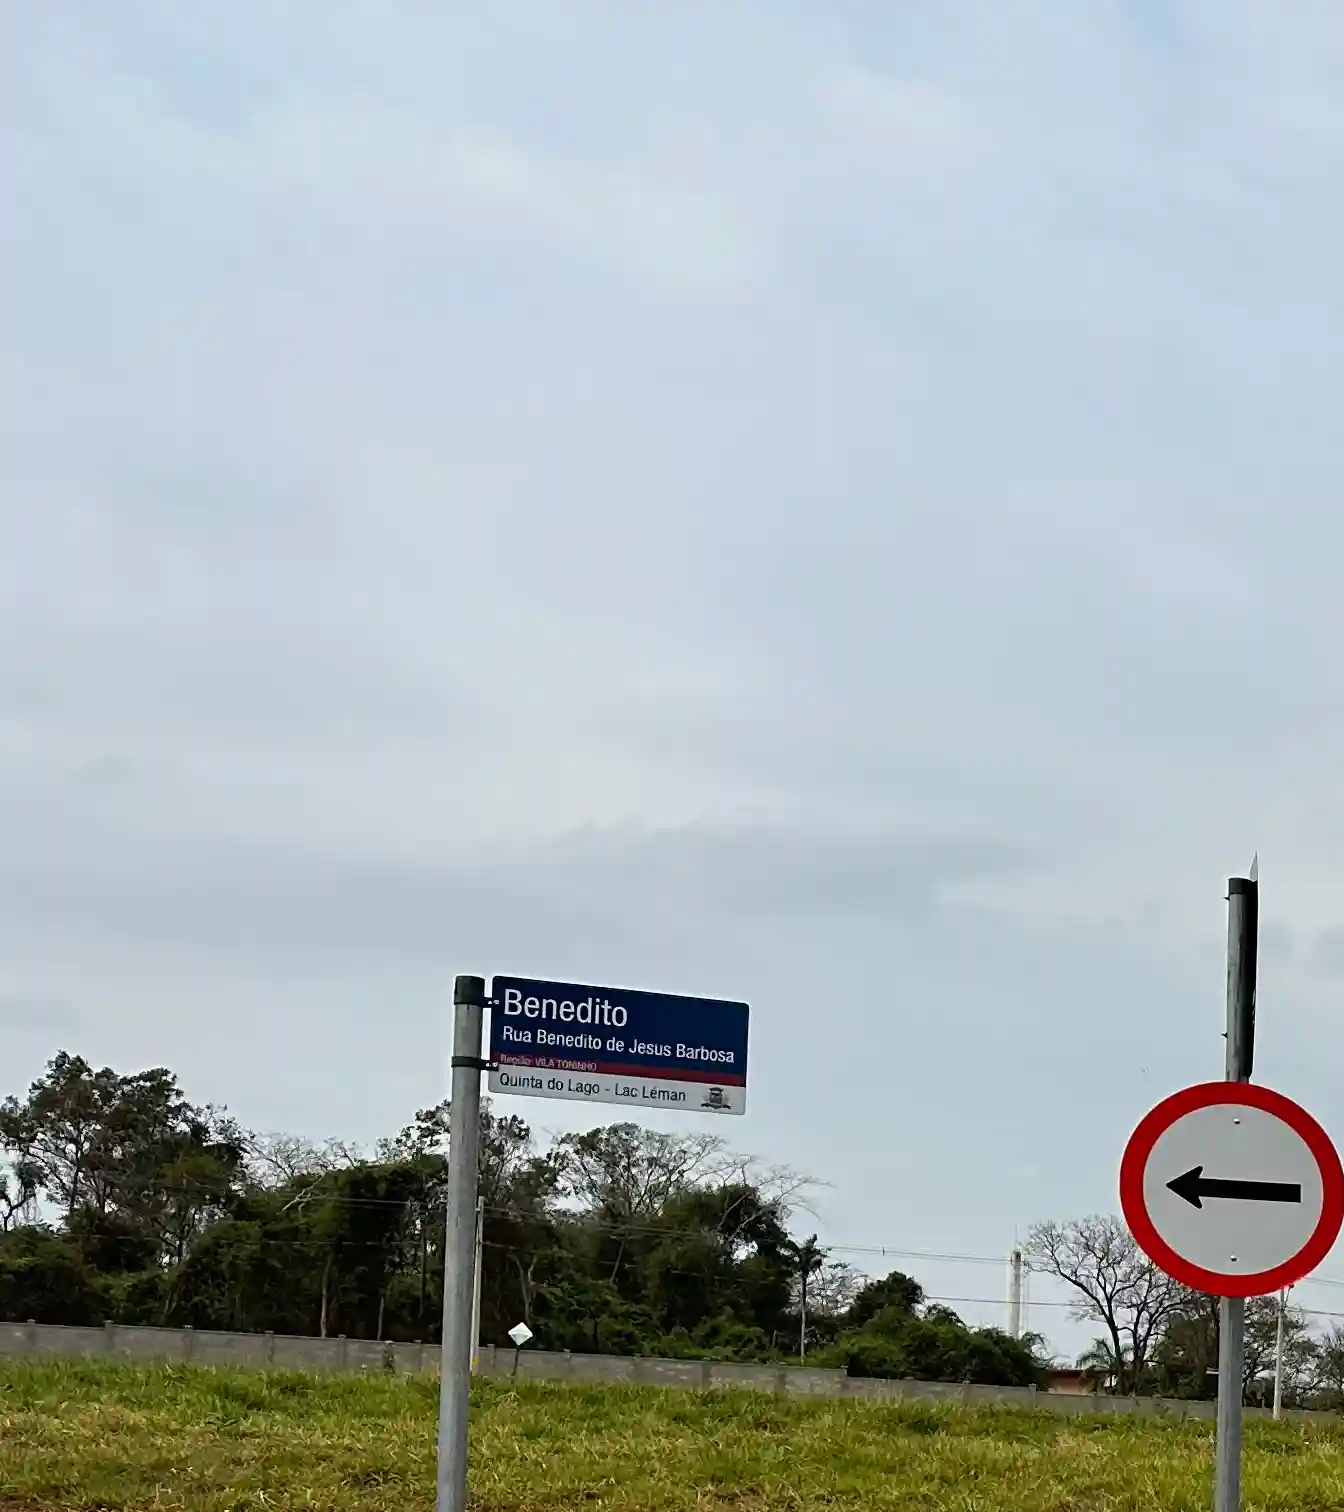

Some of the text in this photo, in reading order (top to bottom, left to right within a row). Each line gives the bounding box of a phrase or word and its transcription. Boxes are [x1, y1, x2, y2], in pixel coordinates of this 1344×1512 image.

[504, 988, 628, 1027] Benedito
[503, 1025, 735, 1063] Rua Benedito de Jesus Barbosa
[535, 1056, 555, 1069] VILA
[500, 1073, 543, 1089] Quinta
[548, 1077, 564, 1091] do
[568, 1079, 600, 1096] Lago
[615, 1083, 638, 1097] Lac
[642, 1085, 686, 1102] Léman
